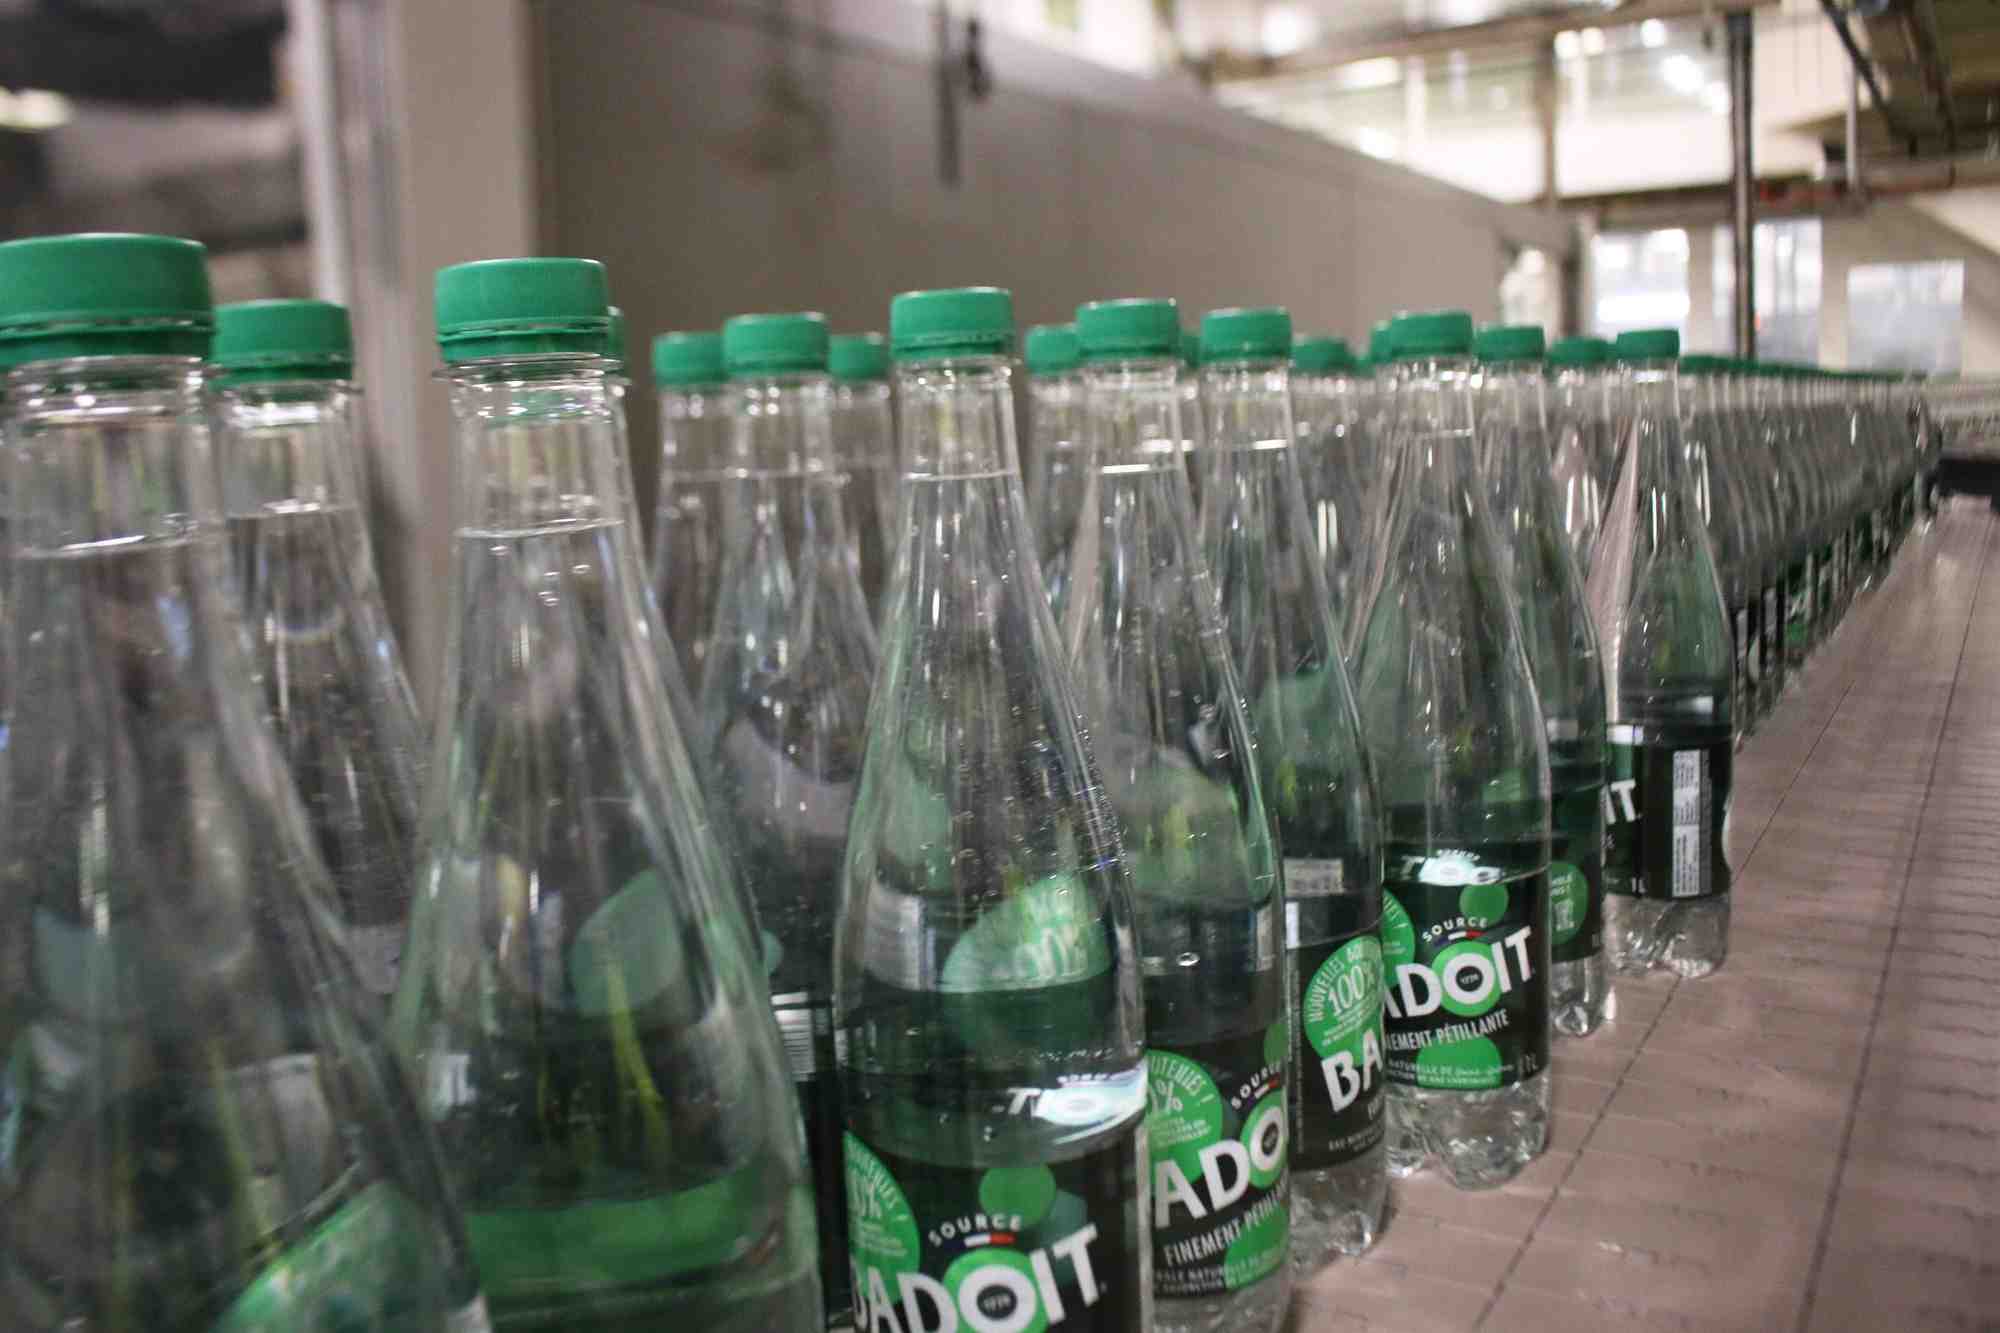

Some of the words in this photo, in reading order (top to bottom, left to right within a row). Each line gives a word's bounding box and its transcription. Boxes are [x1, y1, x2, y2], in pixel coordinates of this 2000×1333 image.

[1421, 916, 1489, 943] SOURCE
[1435, 1008, 1510, 1044] PÉTILLANTE
[928, 1213, 1022, 1248] SOURCE
[1163, 1217, 1242, 1267] FINEMENT
